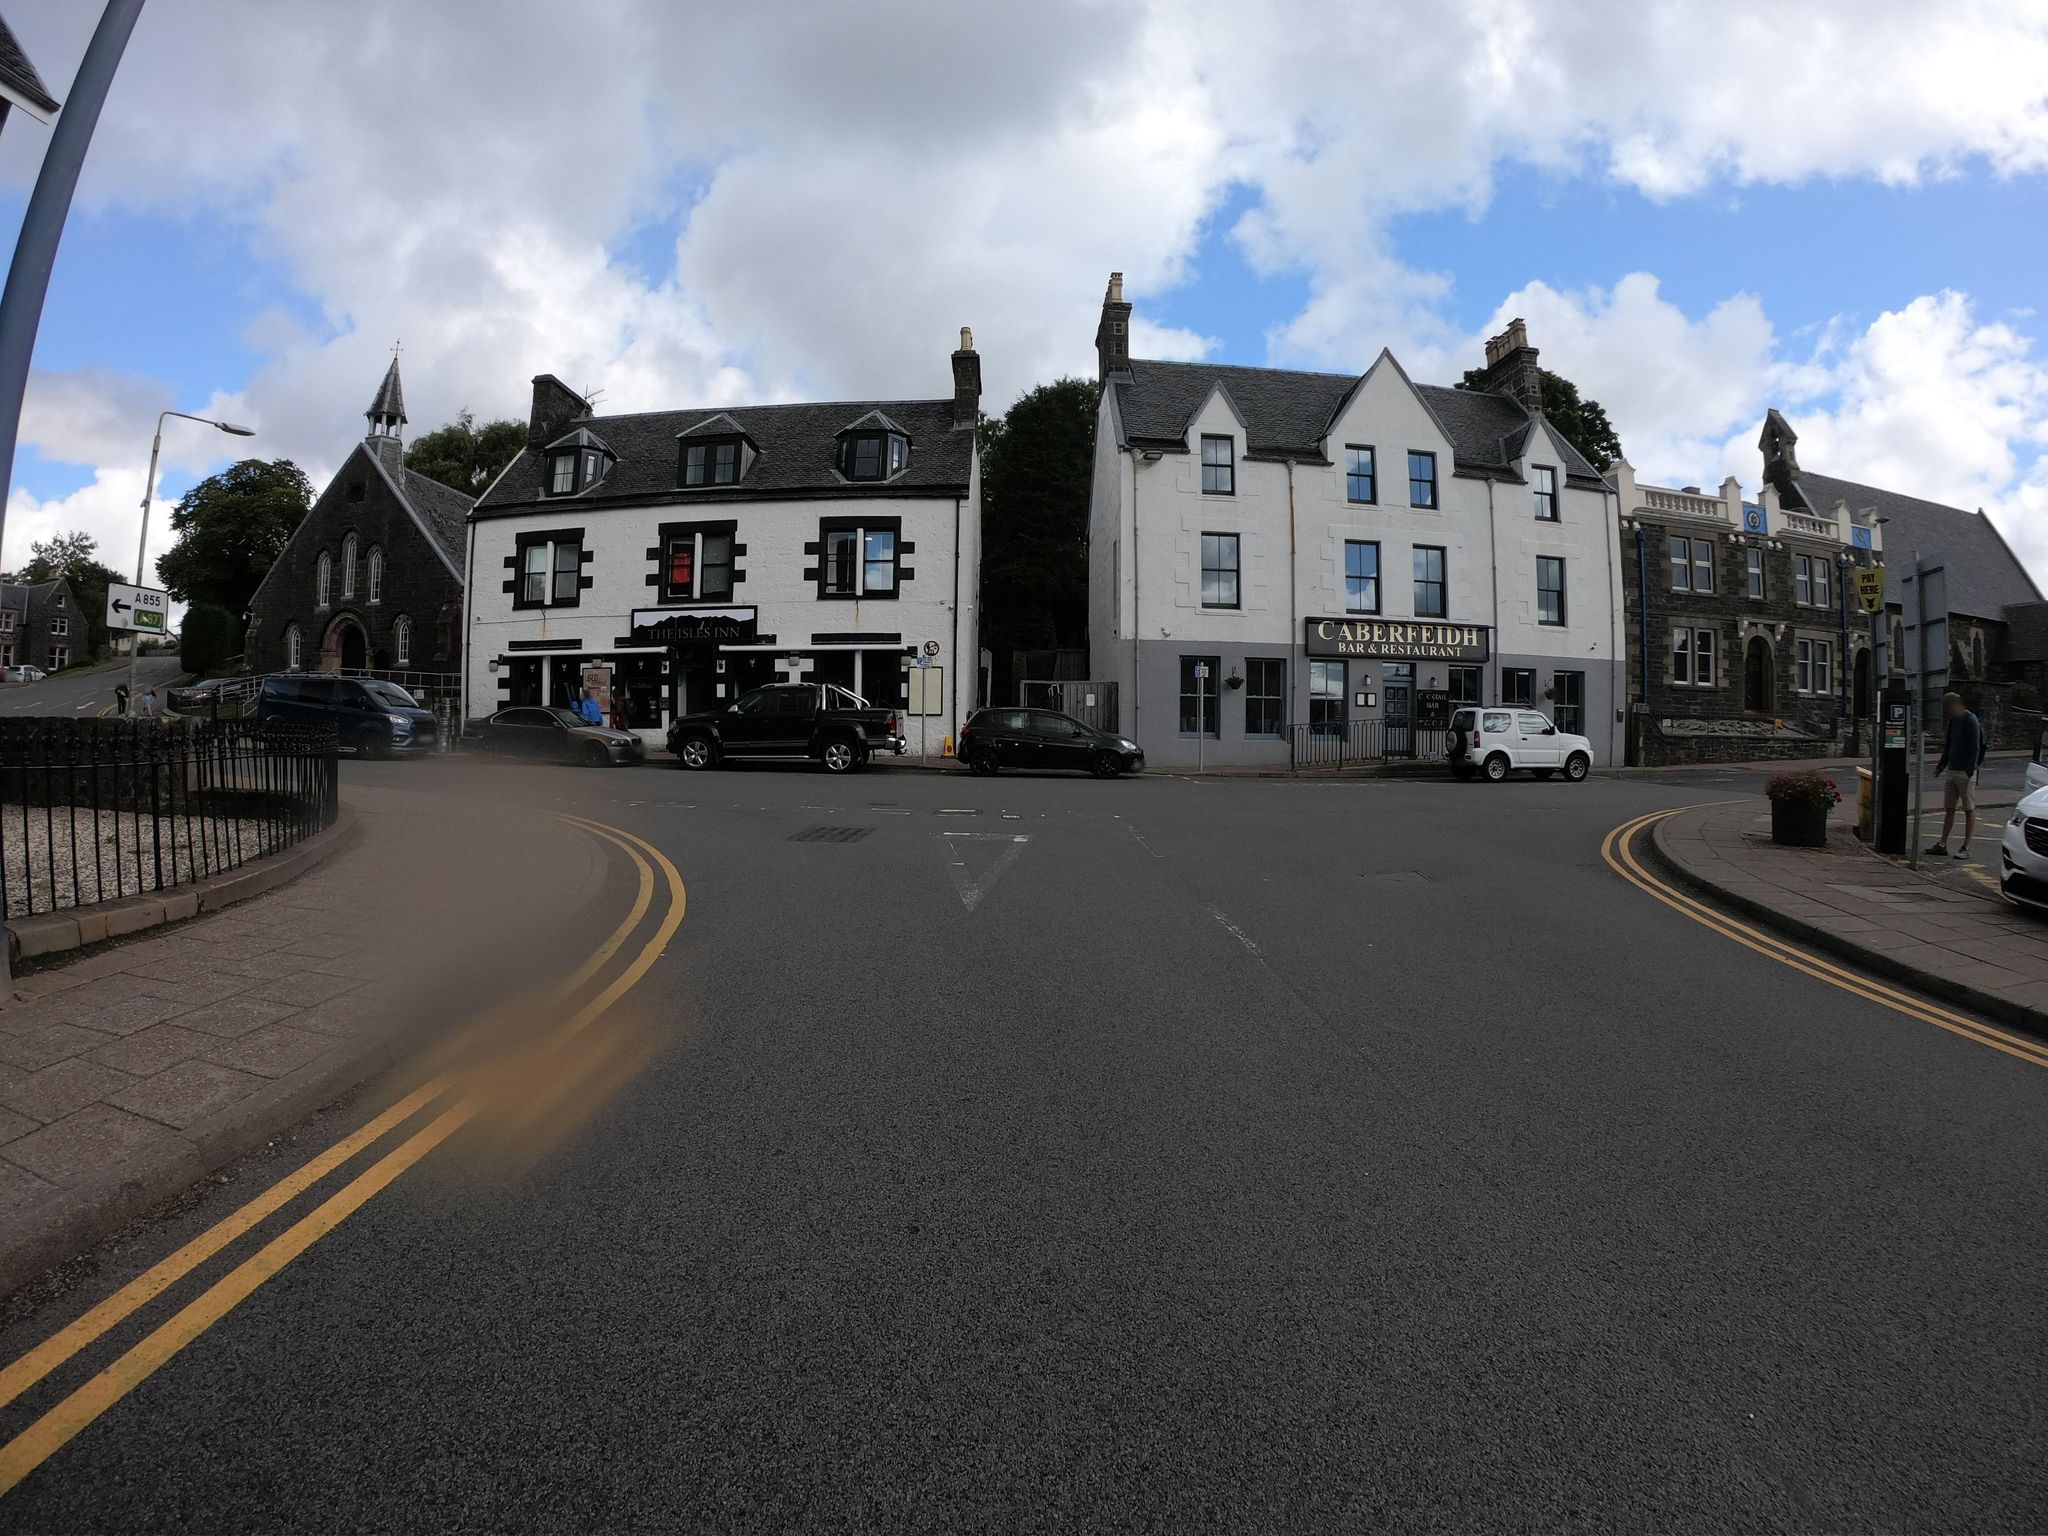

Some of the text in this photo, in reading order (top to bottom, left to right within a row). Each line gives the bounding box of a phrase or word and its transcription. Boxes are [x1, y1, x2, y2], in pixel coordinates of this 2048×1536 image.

[1861, 573, 1875, 583] PAY
[1860, 584, 1879, 595] HERE
[648, 628, 674, 640] THE
[714, 626, 740, 638] INN
[1318, 620, 1480, 646] CABERFEIDH
[1338, 642, 1463, 657] BAR & RESTAURANT
[1418, 692, 1448, 701] CCKTAIL
